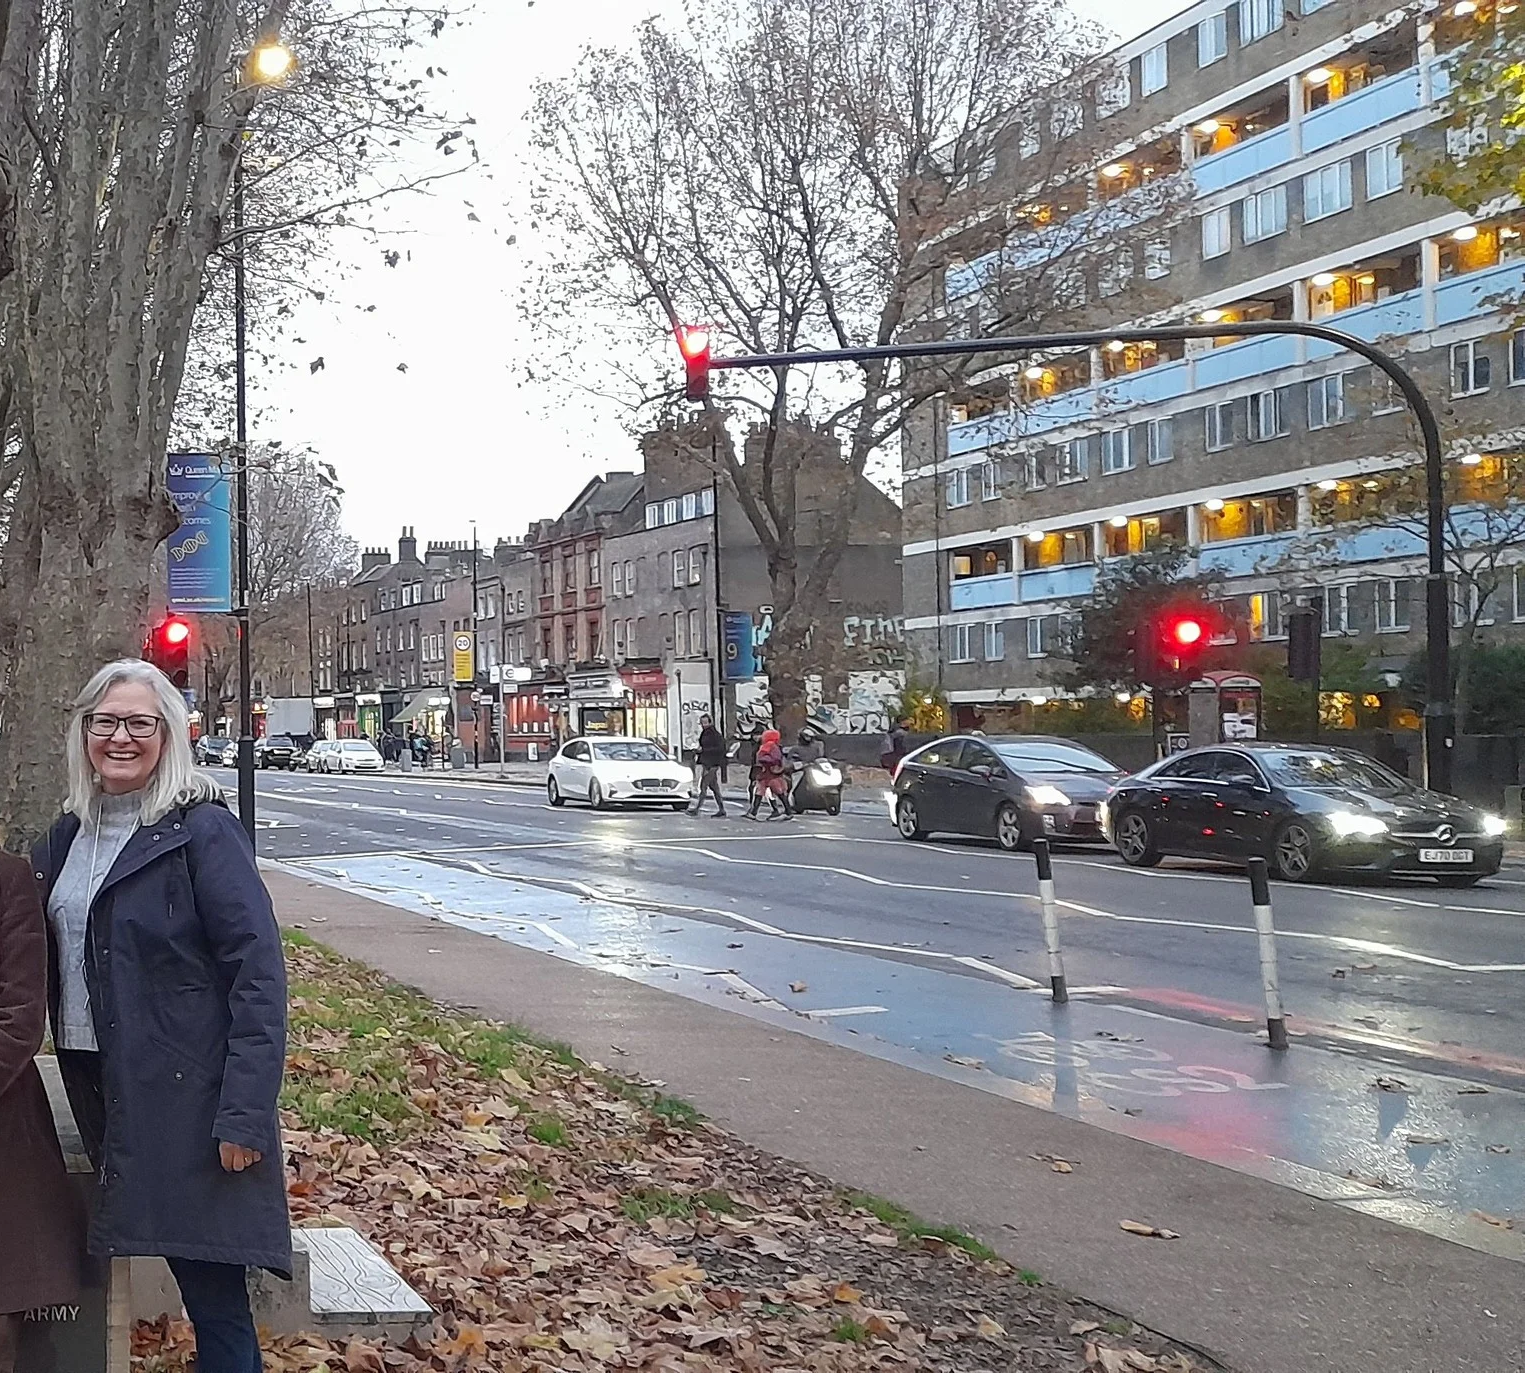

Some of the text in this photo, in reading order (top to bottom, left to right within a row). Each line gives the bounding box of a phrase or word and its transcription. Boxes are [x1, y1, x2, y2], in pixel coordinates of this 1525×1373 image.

[458, 639, 468, 647] 20
[727, 643, 738, 660] 9
[23, 1305, 80, 1321] ARMY
